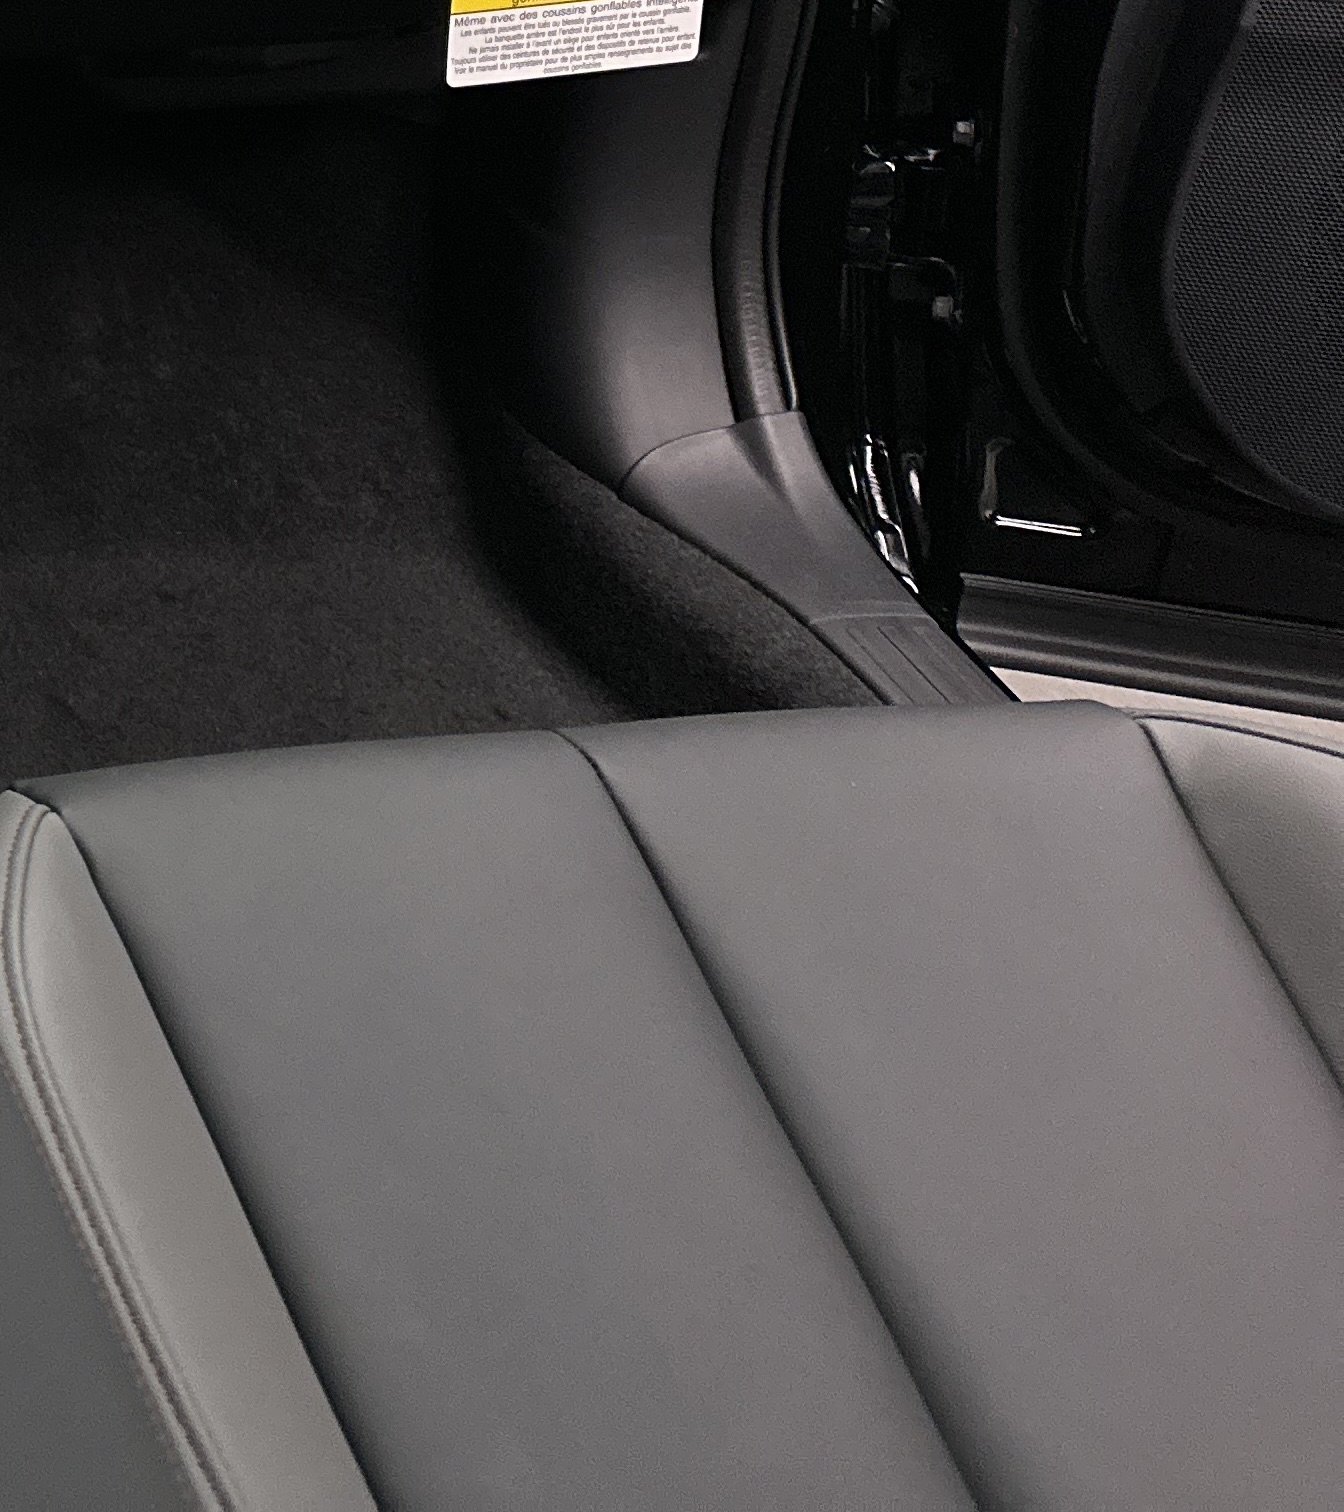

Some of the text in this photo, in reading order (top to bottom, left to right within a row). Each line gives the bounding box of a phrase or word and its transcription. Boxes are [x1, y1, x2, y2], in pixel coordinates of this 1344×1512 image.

[454, 16, 487, 27] Même
[490, 14, 515, 24] avec
[519, 10, 537, 20] des
[542, 5, 586, 18] coussins
[590, 0, 642, 15] gonflables
